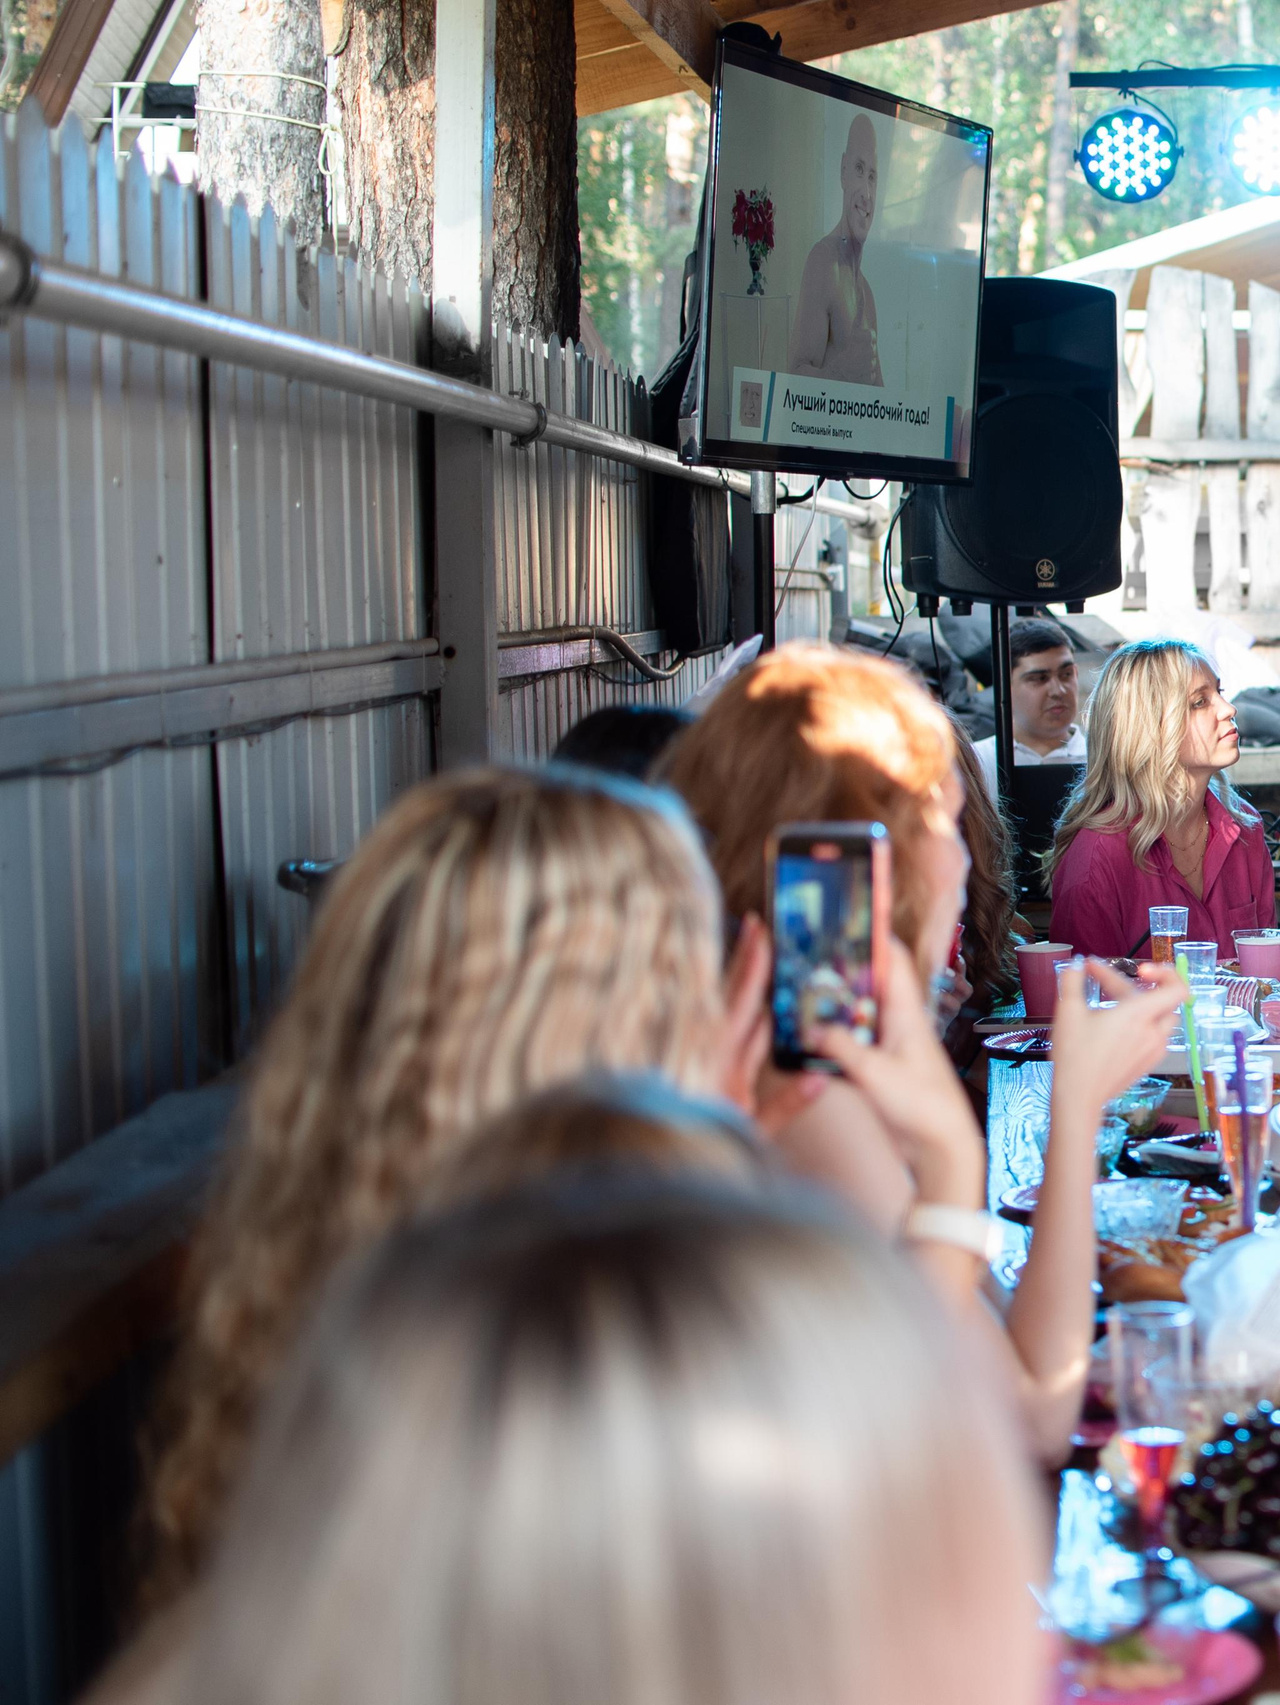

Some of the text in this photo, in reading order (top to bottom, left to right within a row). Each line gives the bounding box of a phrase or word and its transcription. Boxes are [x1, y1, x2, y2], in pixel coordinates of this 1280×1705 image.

[783, 388, 930, 426] Лучший разнорабочий года!
[791, 421, 853, 440] Специальный выпуск
